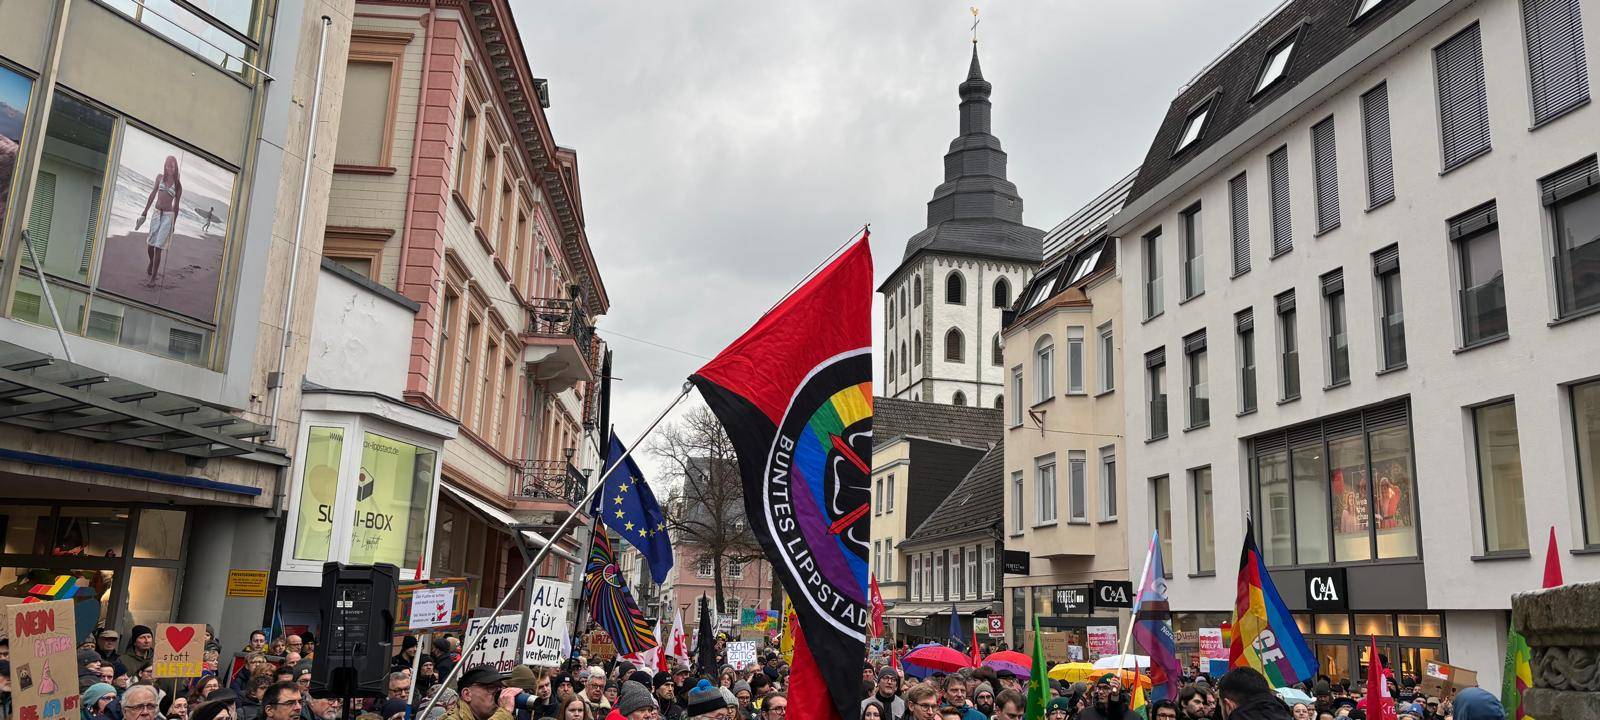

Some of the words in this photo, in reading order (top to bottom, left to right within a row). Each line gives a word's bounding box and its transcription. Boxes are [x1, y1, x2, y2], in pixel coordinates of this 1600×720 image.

[772, 434, 795, 532] BUNTES
[533, 585, 565, 609] Alle
[1056, 590, 1077, 603] PERFECT
[1100, 585, 1129, 603] C&A
[1310, 576, 1339, 601] C&A
[15, 608, 55, 638] NEIN
[531, 608, 557, 631] für
[493, 636, 509, 649] ein
[526, 627, 561, 650] Dumm
[163, 651, 190, 662] statt
